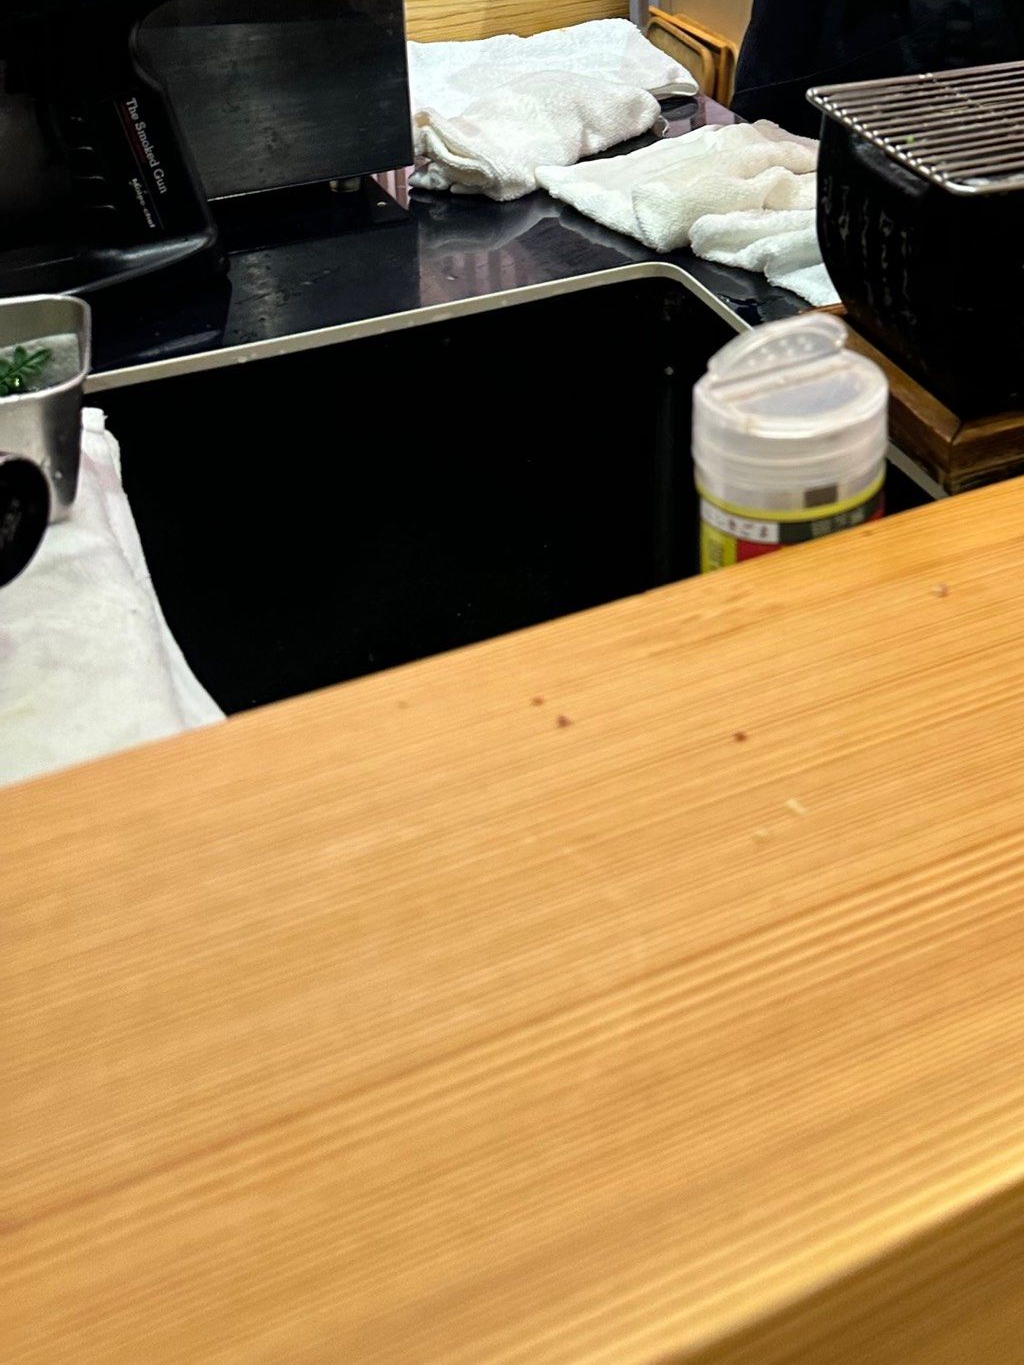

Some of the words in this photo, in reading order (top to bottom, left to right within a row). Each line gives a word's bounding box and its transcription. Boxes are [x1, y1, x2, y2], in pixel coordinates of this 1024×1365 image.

[126, 97, 139, 121] The
[134, 121, 160, 168] Smoked
[153, 168, 167, 194] Gun
